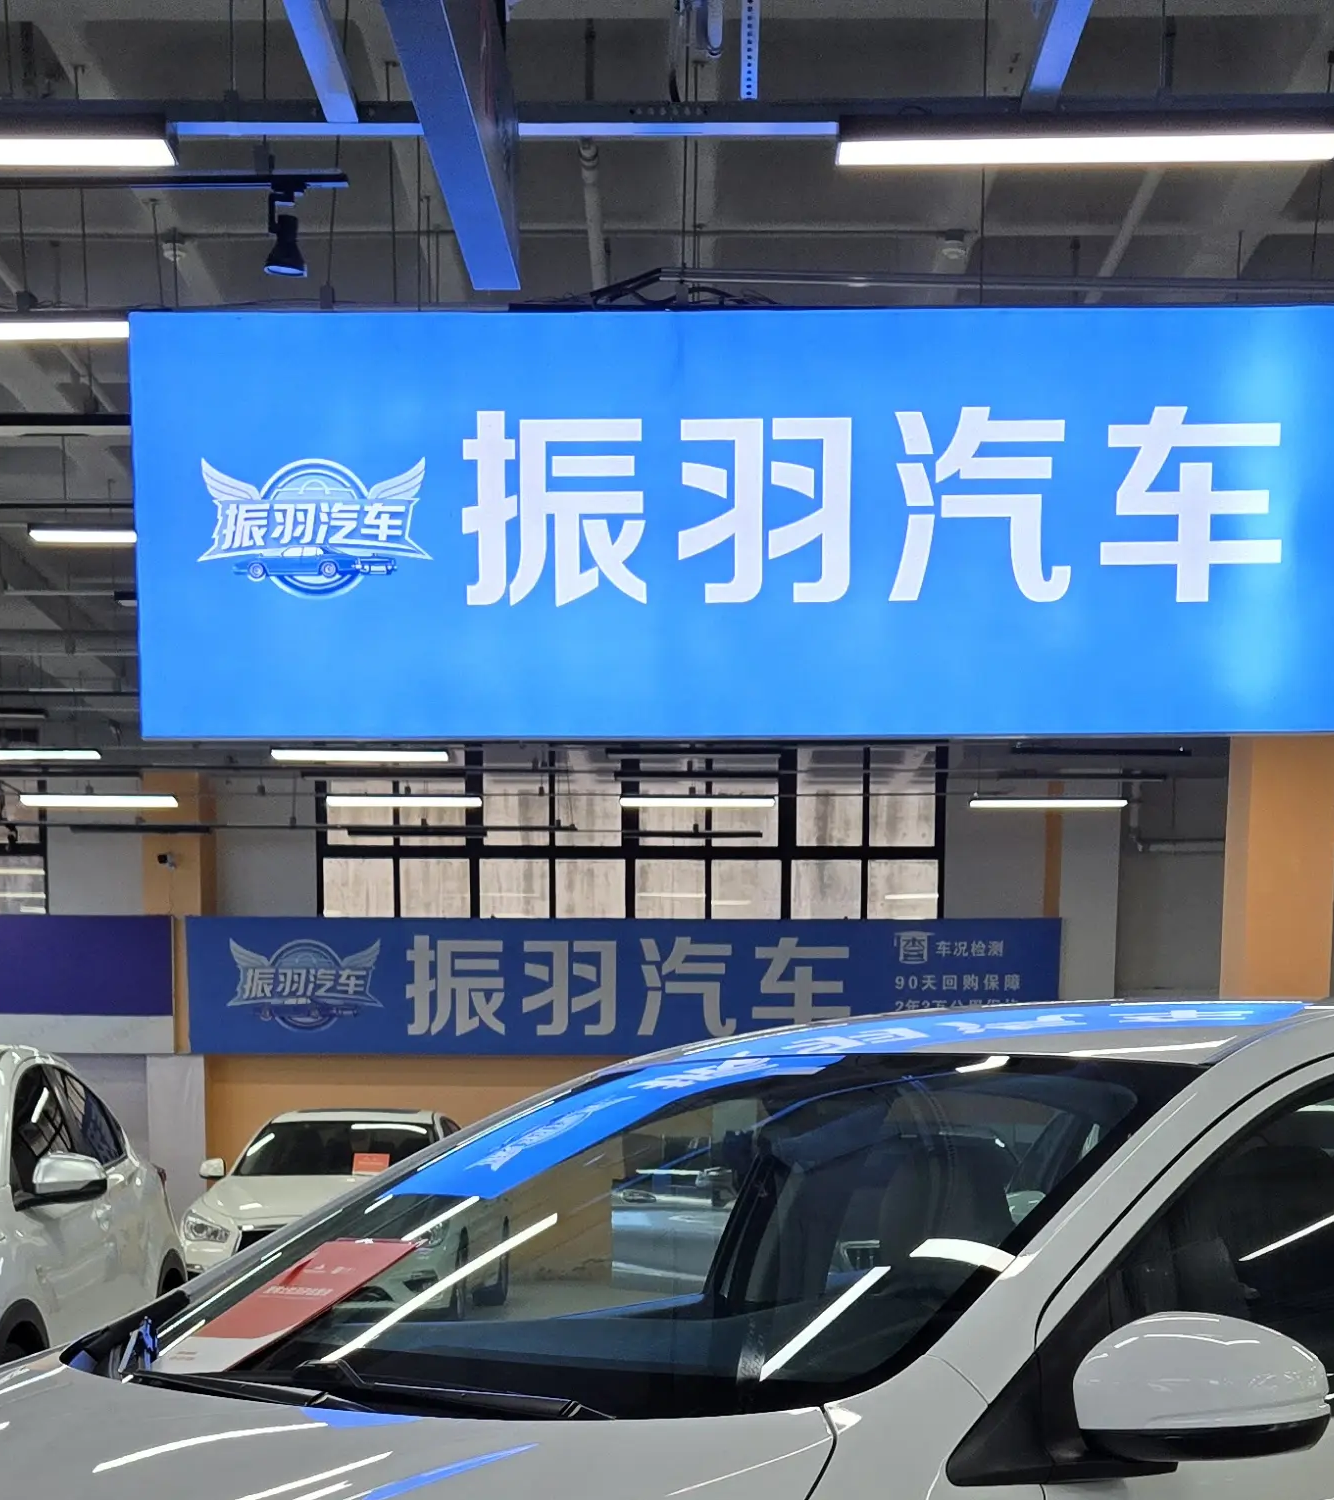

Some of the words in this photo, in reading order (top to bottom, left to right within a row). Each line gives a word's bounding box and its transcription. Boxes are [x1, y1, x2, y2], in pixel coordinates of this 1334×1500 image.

[221, 502, 405, 549] 振羽汽车
[462, 405, 1283, 607] 振羽汽车
[935, 940, 1005, 958] 车况检测
[243, 968, 367, 999] 振羽汽车
[405, 935, 851, 1037] 振羽汽车
